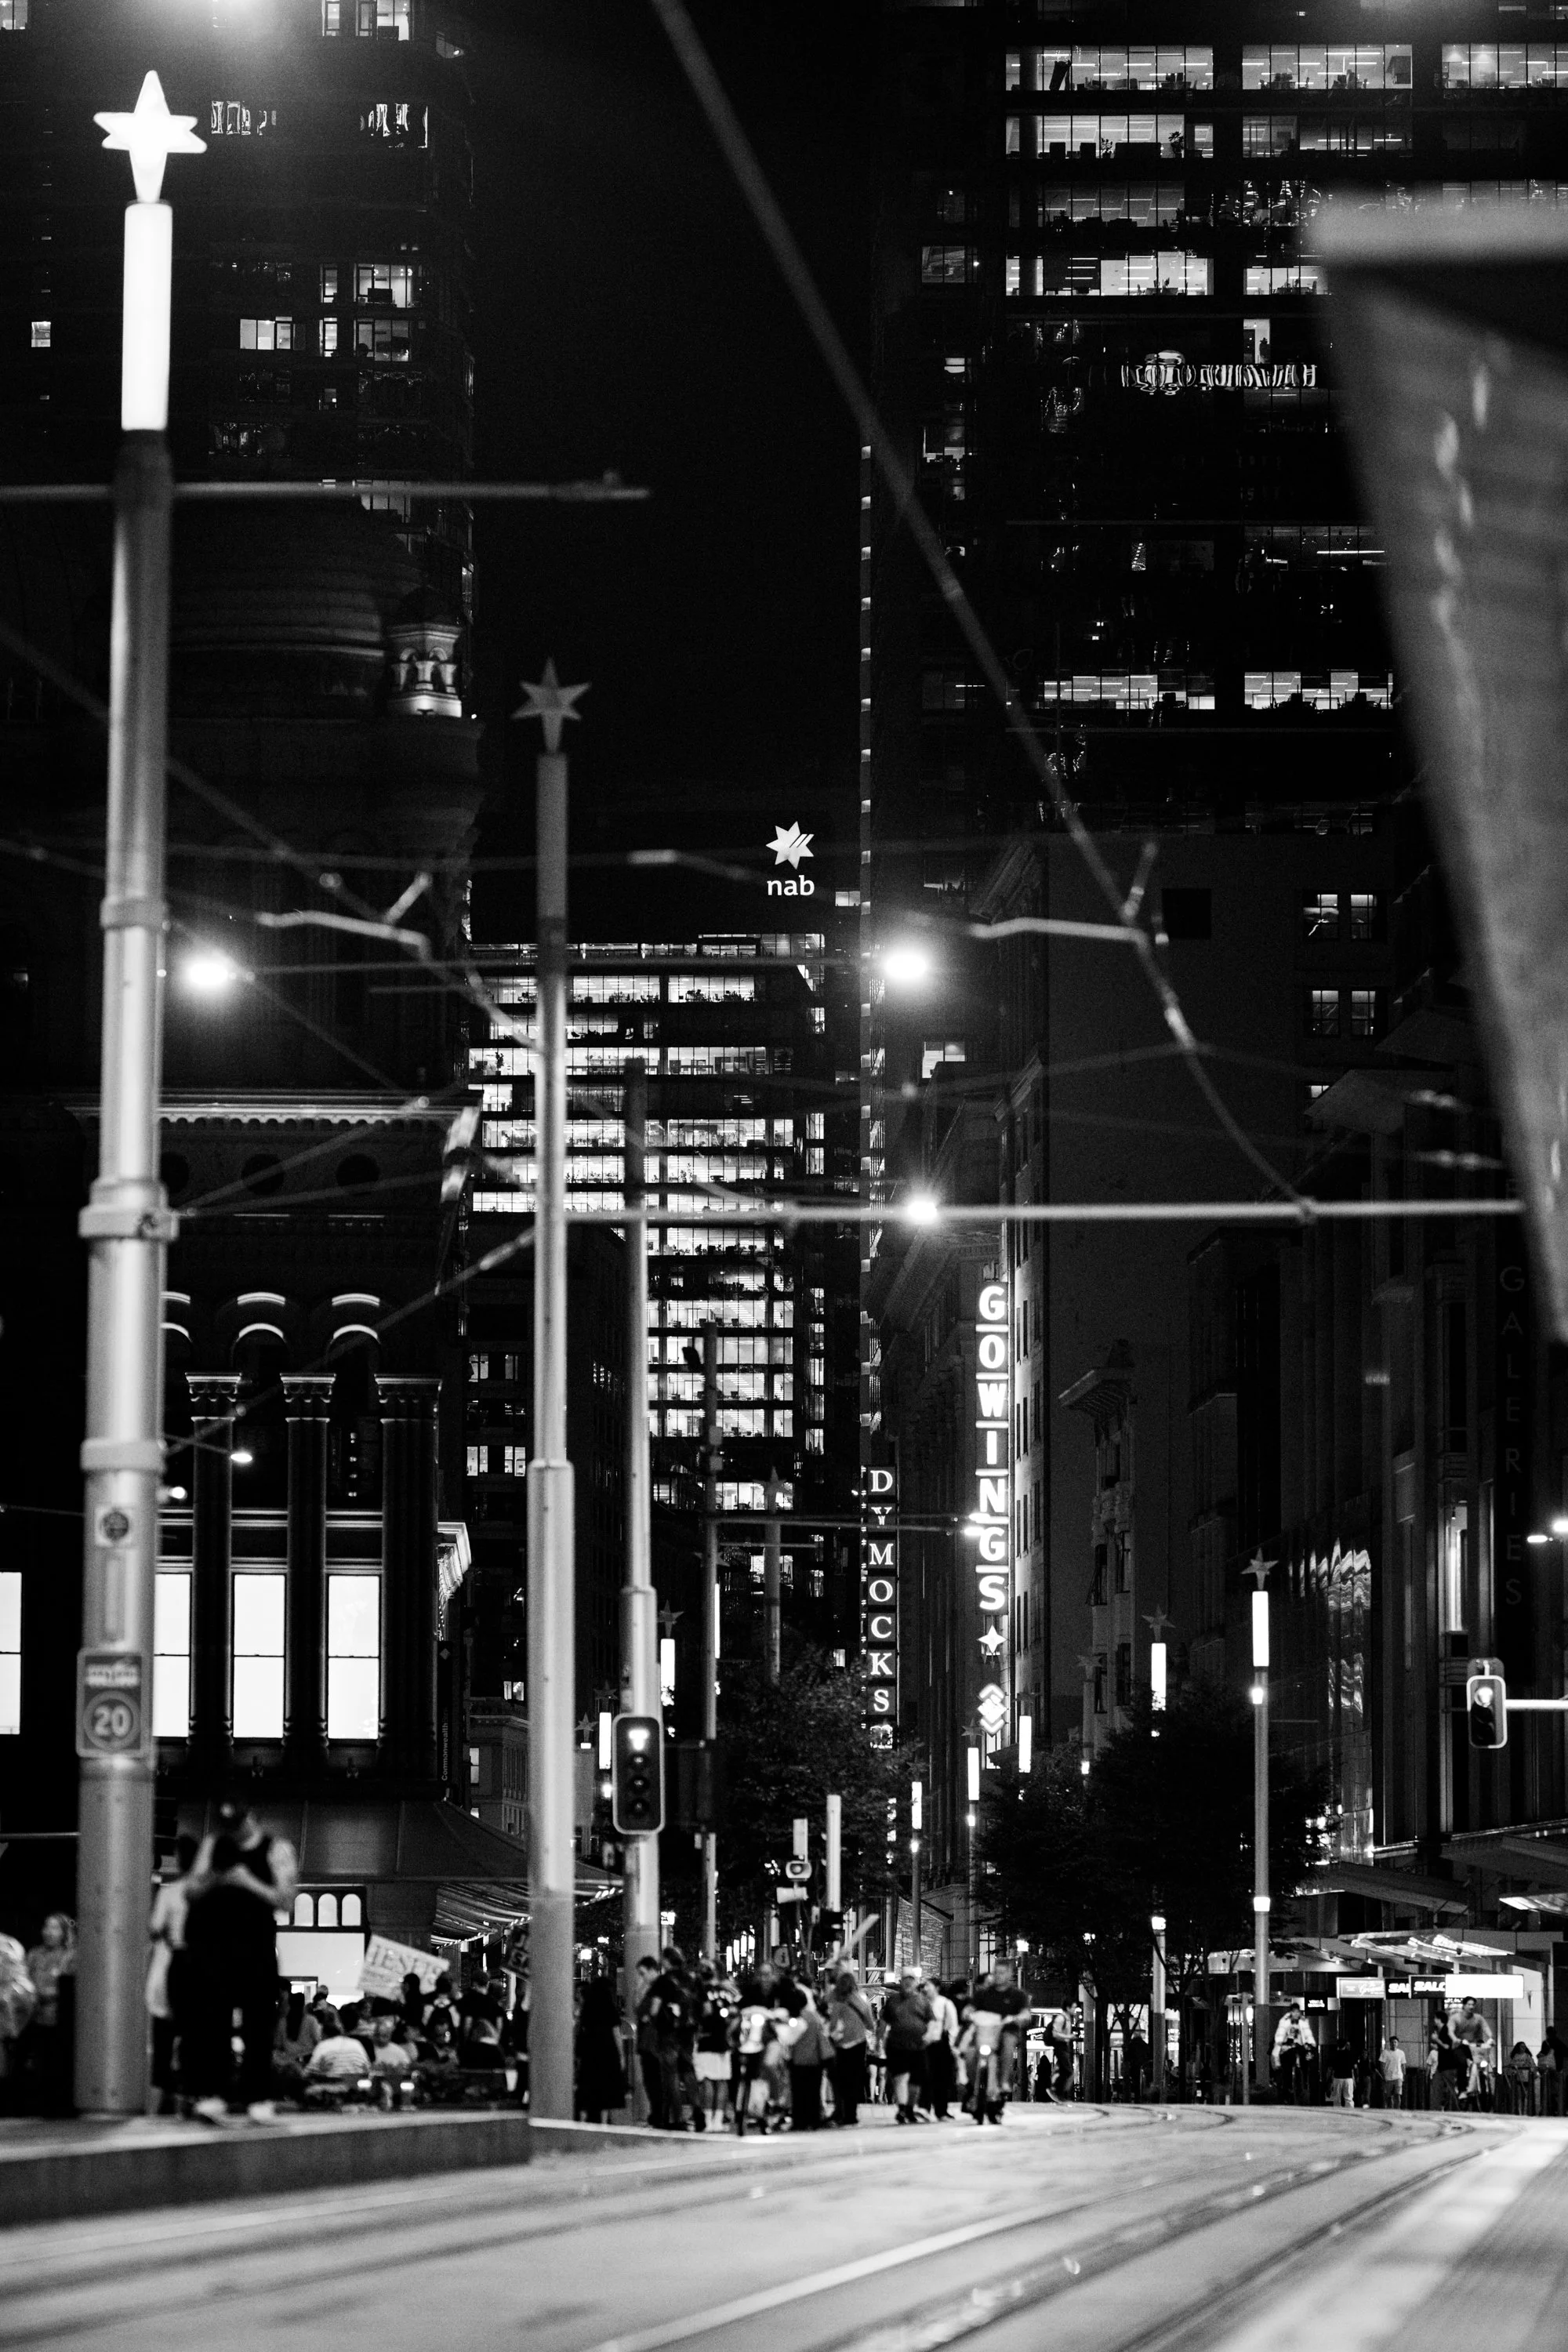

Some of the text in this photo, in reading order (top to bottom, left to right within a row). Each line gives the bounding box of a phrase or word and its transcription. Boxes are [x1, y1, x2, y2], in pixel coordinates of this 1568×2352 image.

[767, 875, 815, 896] nab
[978, 1286, 1007, 1611] GOWINGS
[869, 1468, 895, 1713] DYMOCKS
[93, 1704, 132, 1737] 20
